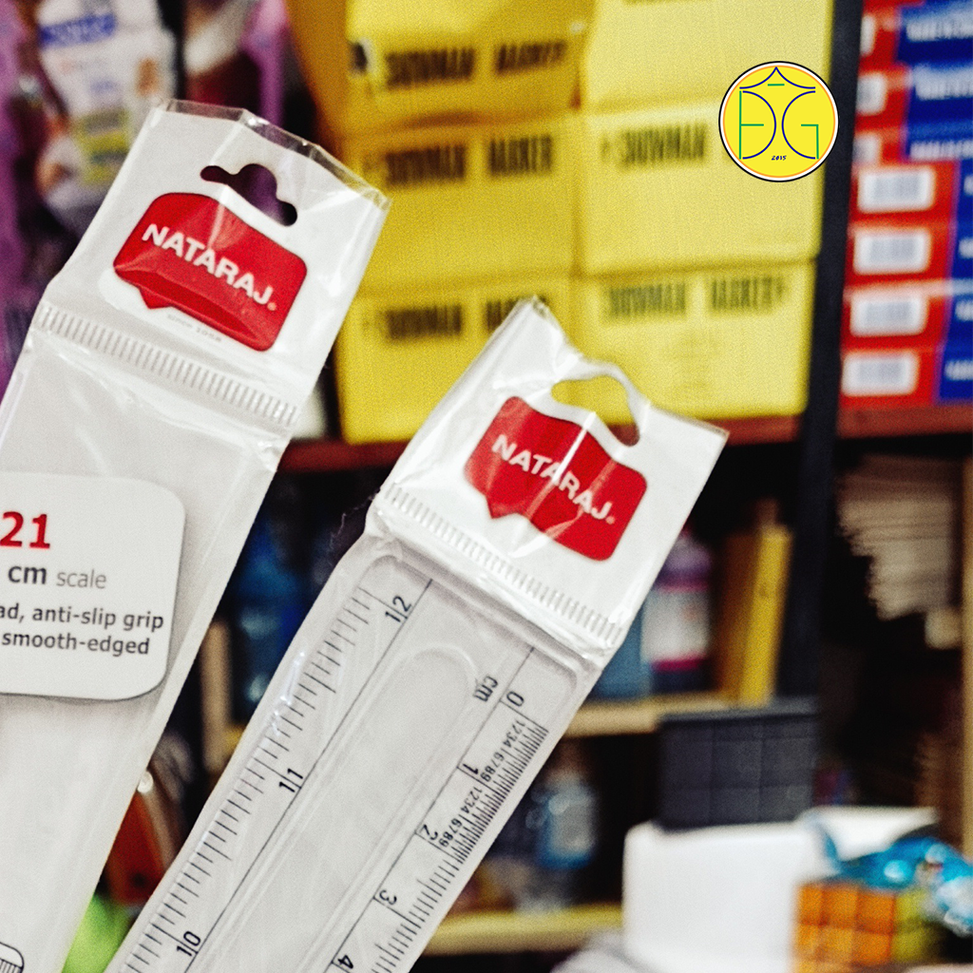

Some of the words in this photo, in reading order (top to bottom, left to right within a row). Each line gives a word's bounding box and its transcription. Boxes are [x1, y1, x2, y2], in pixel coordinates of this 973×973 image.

[141, 223, 274, 305] NATARAJ
[491, 434, 613, 520] NATARAJ
[8, 564, 48, 585] cm
[56, 569, 107, 589] scale
[32, 606, 116, 630] anti-slip
[123, 611, 164, 633] grip
[385, 595, 412, 622] 12
[1, 631, 150, 657] smooth-edged
[473, 675, 498, 702] cm
[506, 690, 524, 707] 0
[279, 768, 303, 793] 11
[463, 763, 479, 775] 1
[419, 824, 438, 841] 2
[379, 889, 397, 905] 3
[176, 931, 201, 956] 10
[337, 954, 354, 970] 4
